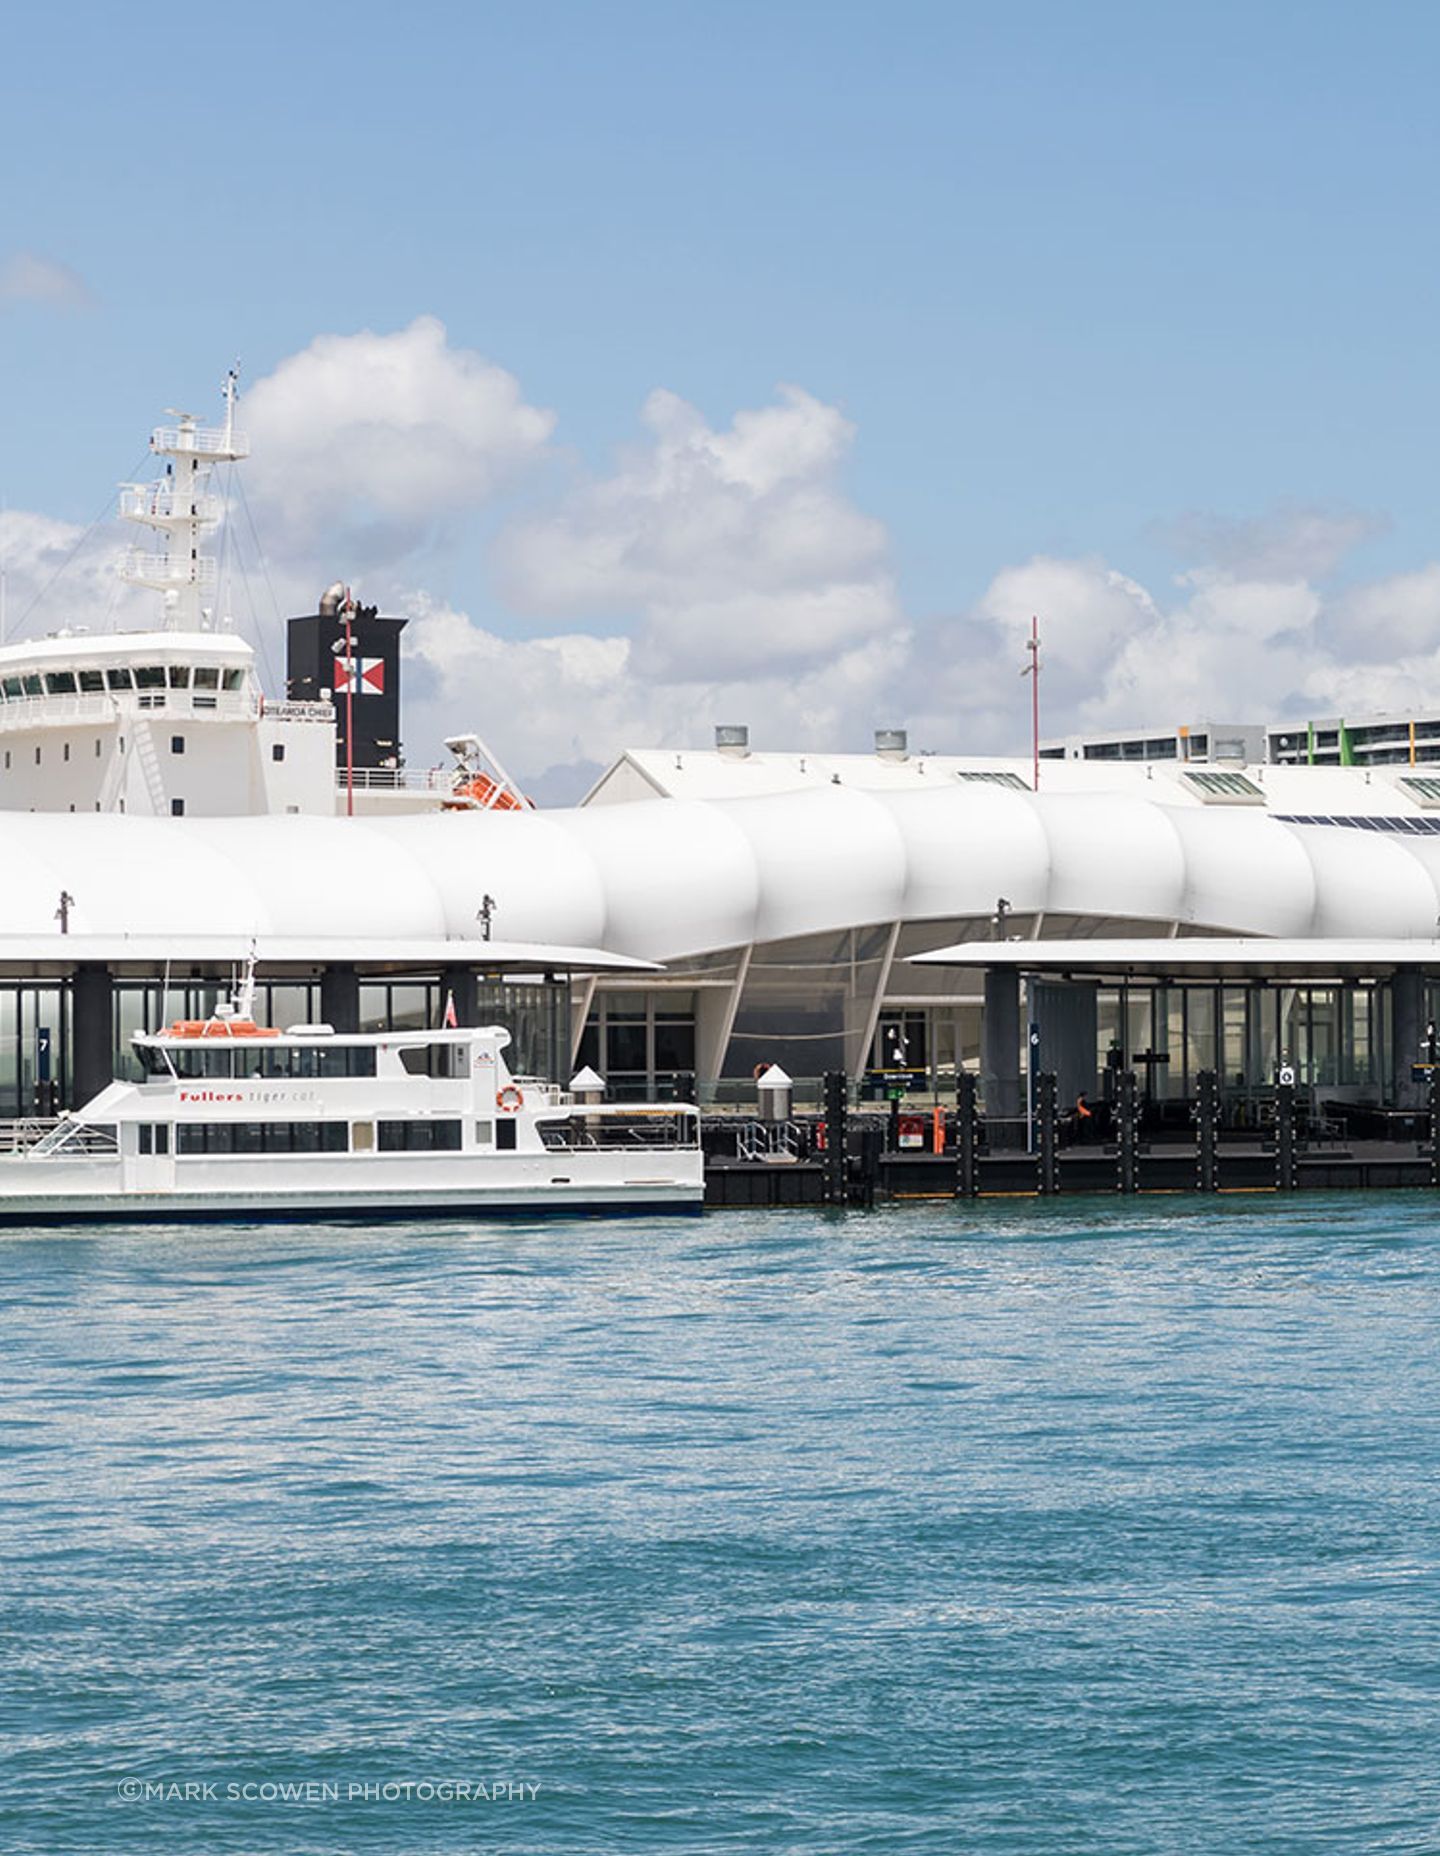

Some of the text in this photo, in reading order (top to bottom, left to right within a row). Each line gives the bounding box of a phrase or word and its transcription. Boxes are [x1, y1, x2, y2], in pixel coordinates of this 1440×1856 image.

[1031, 1032, 1040, 1045] 6
[40, 1039, 48, 1051] 7
[180, 1092, 243, 1101] Fullers
